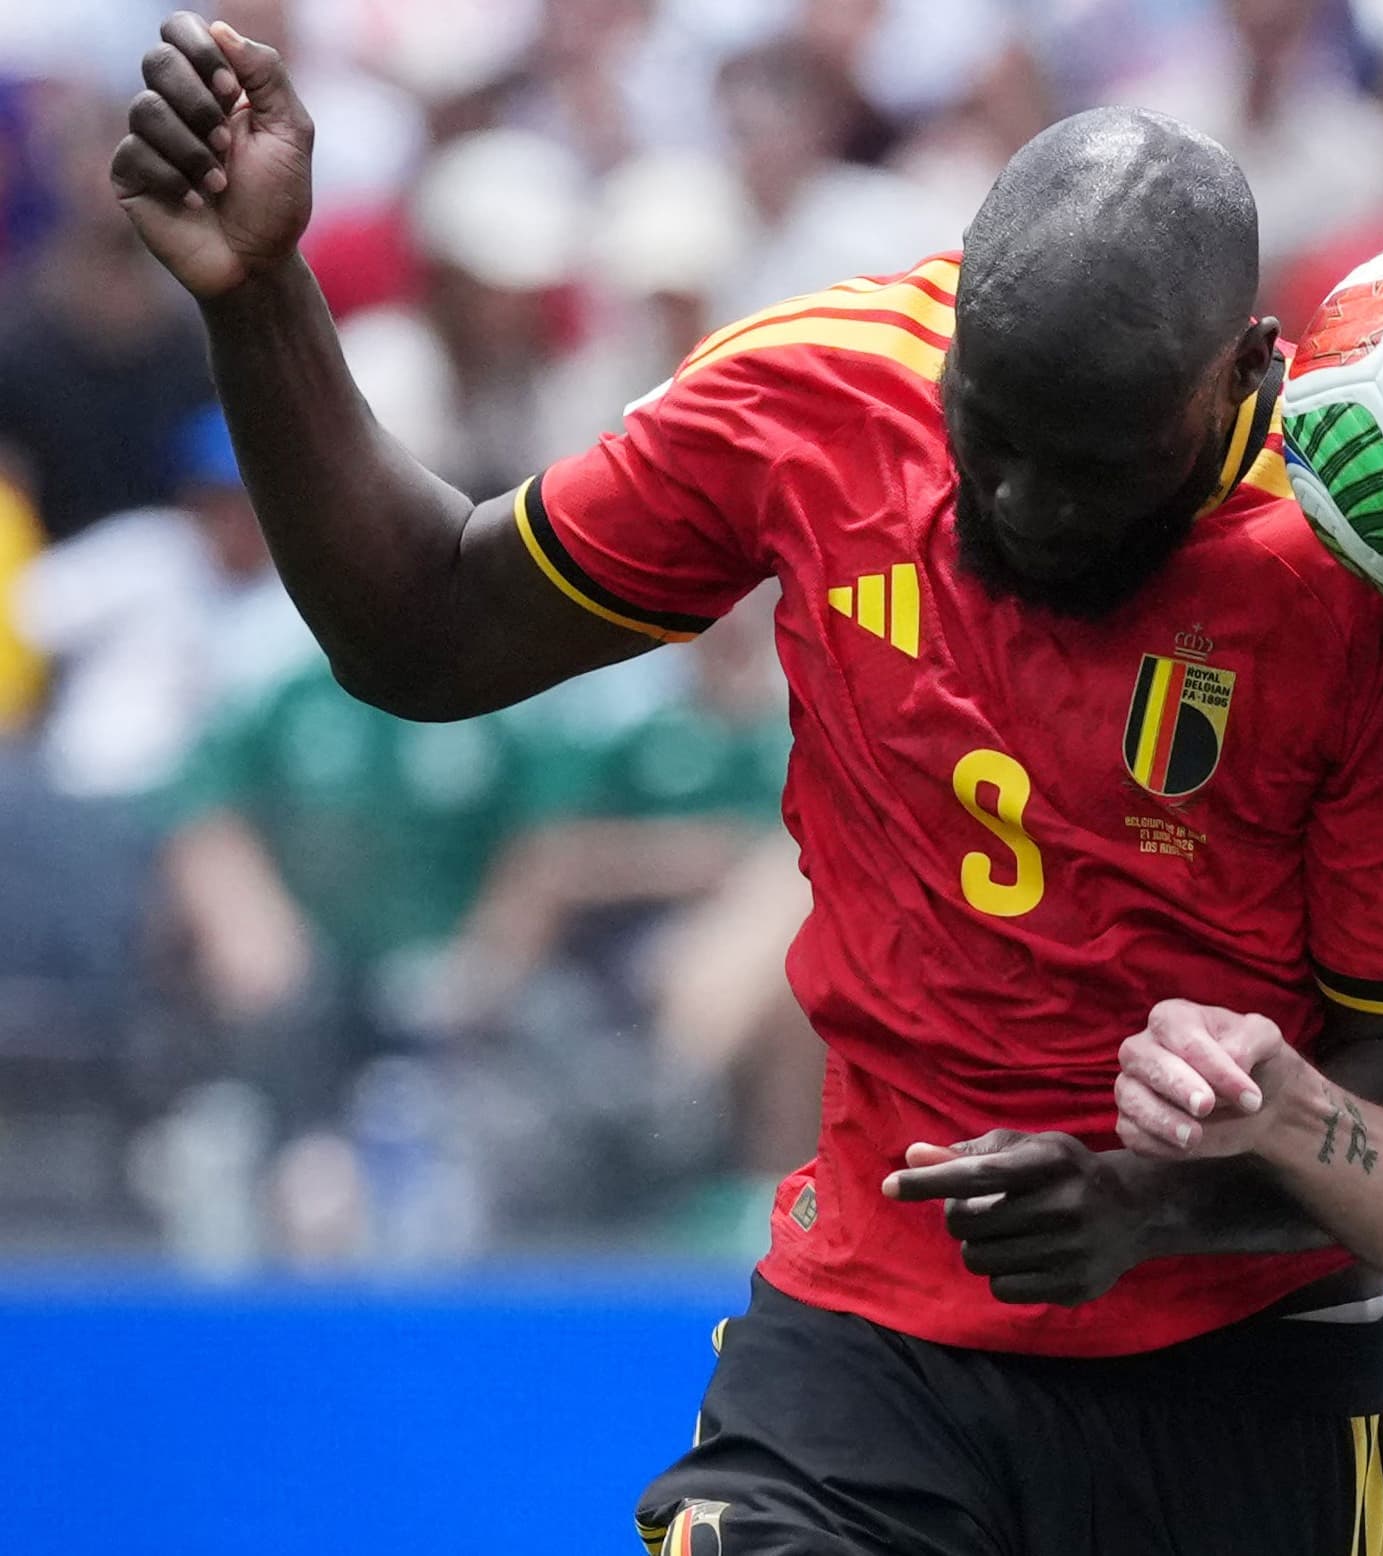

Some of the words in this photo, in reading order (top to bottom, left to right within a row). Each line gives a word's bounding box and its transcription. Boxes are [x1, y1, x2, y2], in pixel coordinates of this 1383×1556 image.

[1187, 666, 1220, 683] ROYAL
[1184, 678, 1231, 697] BELGIAN
[953, 749, 1044, 917] 9
[1139, 840, 1158, 853] LOS
